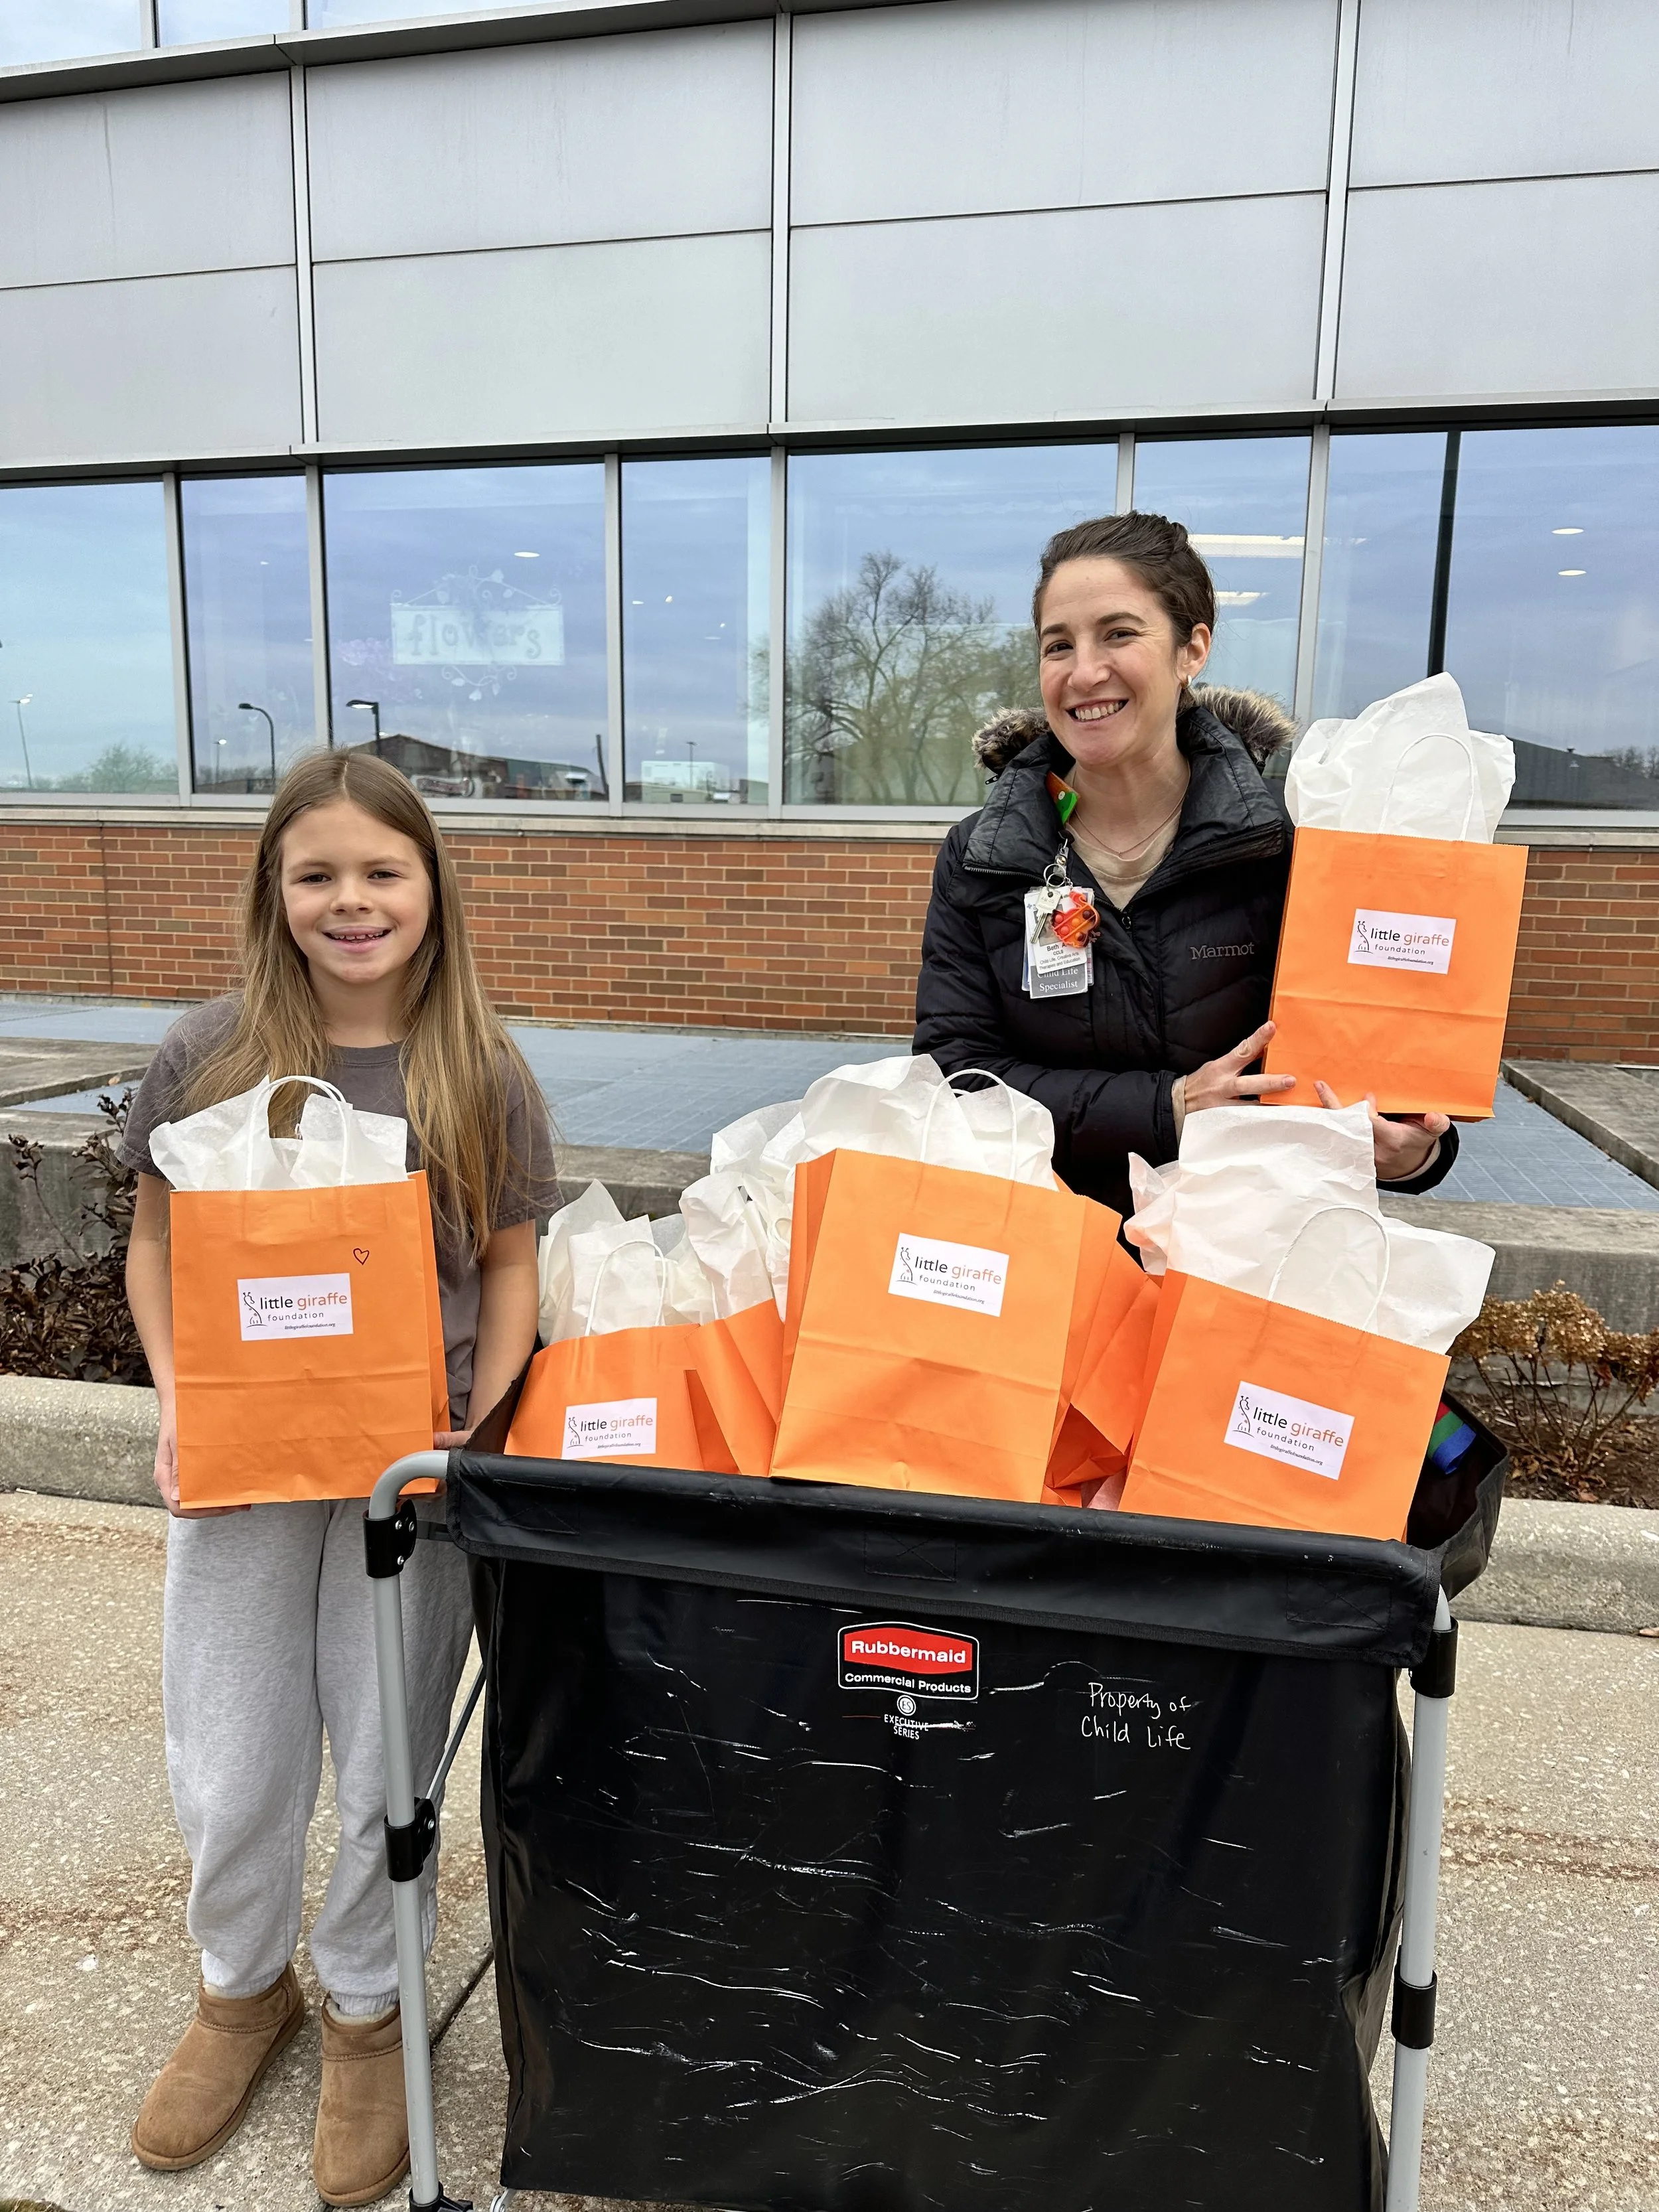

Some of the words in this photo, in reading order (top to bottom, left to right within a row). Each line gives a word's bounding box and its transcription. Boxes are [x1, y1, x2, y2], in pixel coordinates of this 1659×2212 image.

[1370, 928, 1400, 941] little
[1404, 932, 1449, 946] giraffe
[1190, 942, 1254, 960] Marmot
[1375, 944, 1425, 955] foundation
[1039, 980, 1078, 993] Specialist
[914, 1256, 948, 1273] little
[952, 1265, 1002, 1284] giraffe
[919, 1274, 975, 1291] foundation
[260, 1295, 293, 1309] little
[297, 1292, 347, 1311] giraffe
[267, 1311, 324, 1321] foundation
[580, 1419, 607, 1432] little
[610, 1415, 653, 1431] giraffe
[1253, 1407, 1287, 1429] little
[1290, 1422, 1344, 1447] giraffe
[585, 1432, 632, 1442] foundation
[1256, 1427, 1315, 1451] foundation
[851, 1640, 966, 1664] Rubbermaid
[845, 1672, 915, 1688] Commercial
[918, 1680, 972, 1693] Products
[902, 1700, 912, 1711] ES
[1088, 1682, 1161, 1720] Property
[1169, 1696, 1192, 1712] of
[884, 1714, 929, 1732] EXECUTIVE
[893, 1726, 920, 1740] SERIES
[1081, 1715, 1130, 1743] Child
[1147, 1725, 1191, 1750] Life
